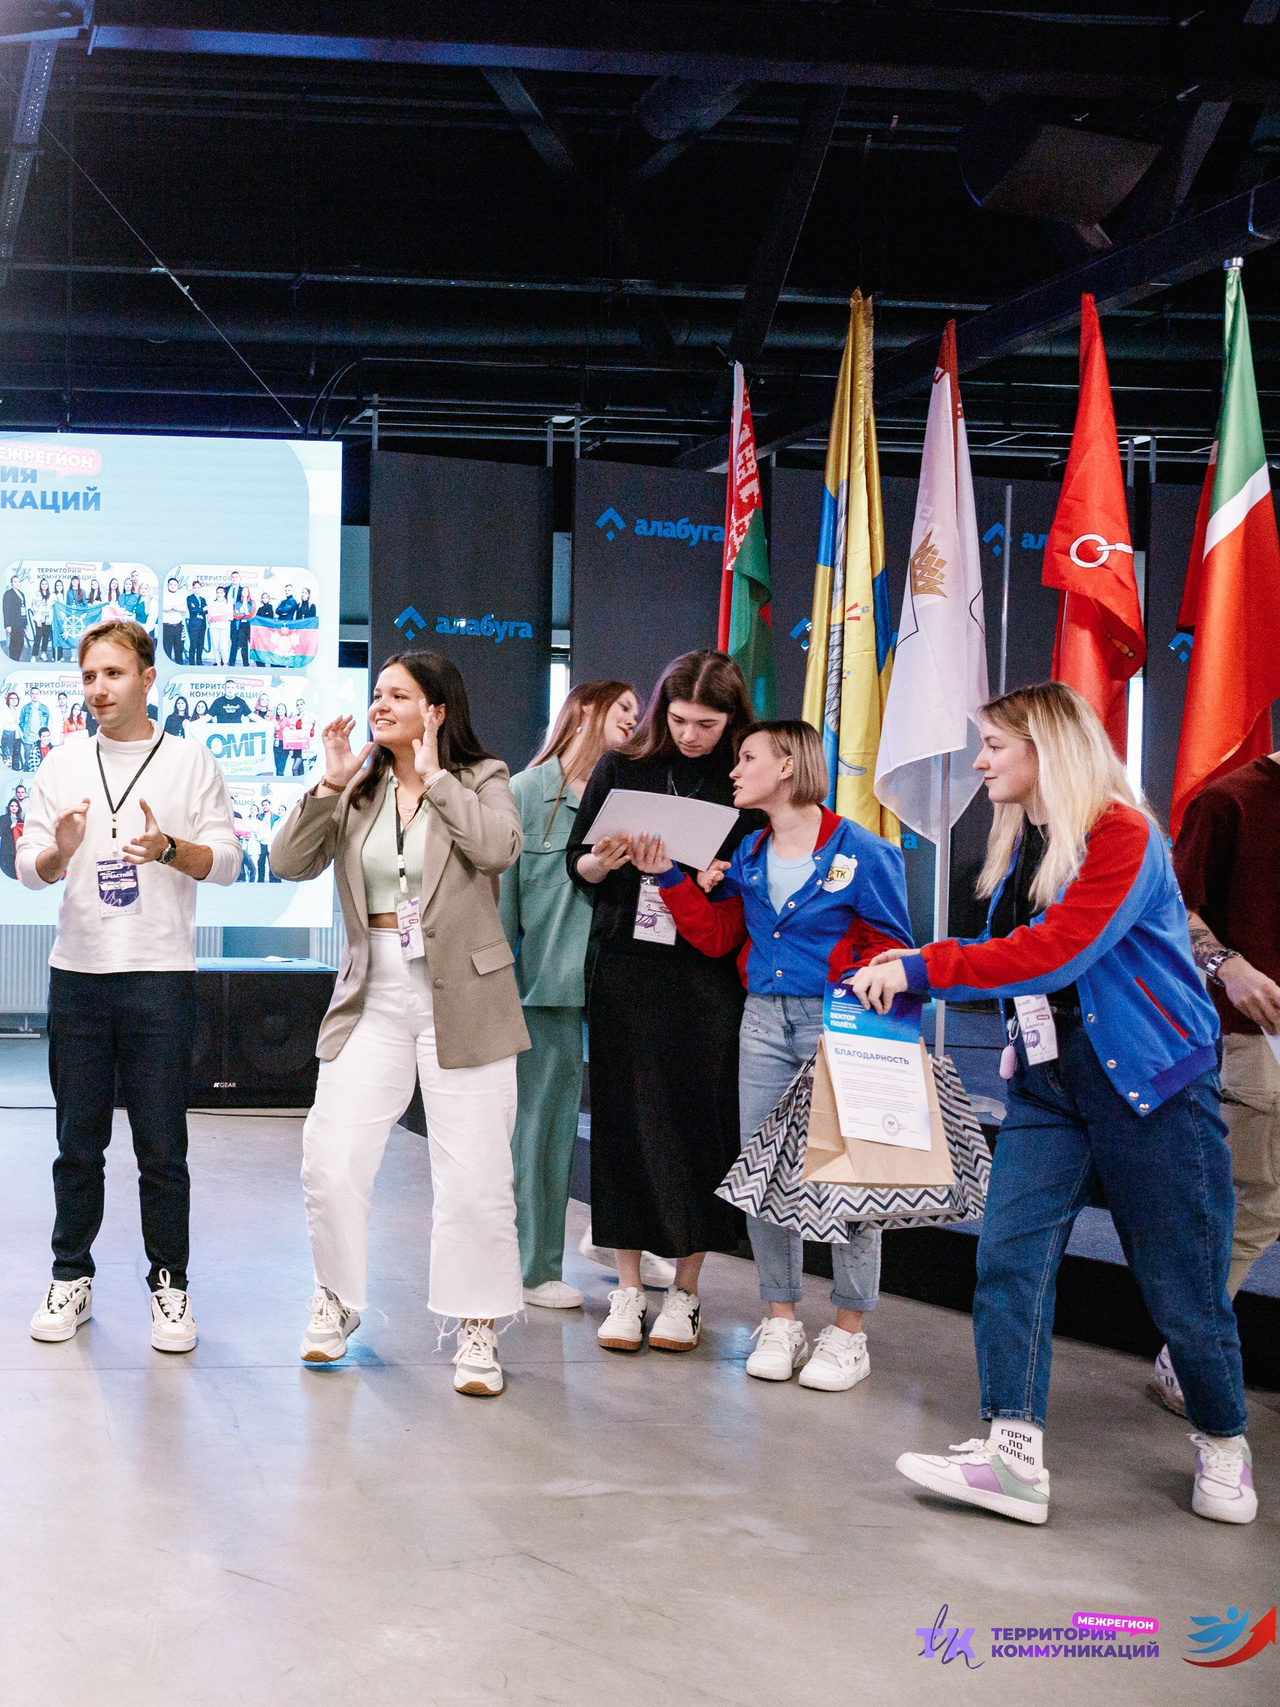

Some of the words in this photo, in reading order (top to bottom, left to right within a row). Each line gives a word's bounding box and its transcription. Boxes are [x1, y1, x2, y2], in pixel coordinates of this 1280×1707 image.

[634, 517, 726, 546] алабуга
[435, 614, 533, 643] алабуга
[206, 731, 266, 759] ОМП
[830, 1012, 856, 1021] ВЕКТОР
[834, 1048, 909, 1065] БЛАГОДАРНОСТЬ
[1001, 1428, 1032, 1443] ГОРЫ
[1008, 1439, 1023, 1450] ПО
